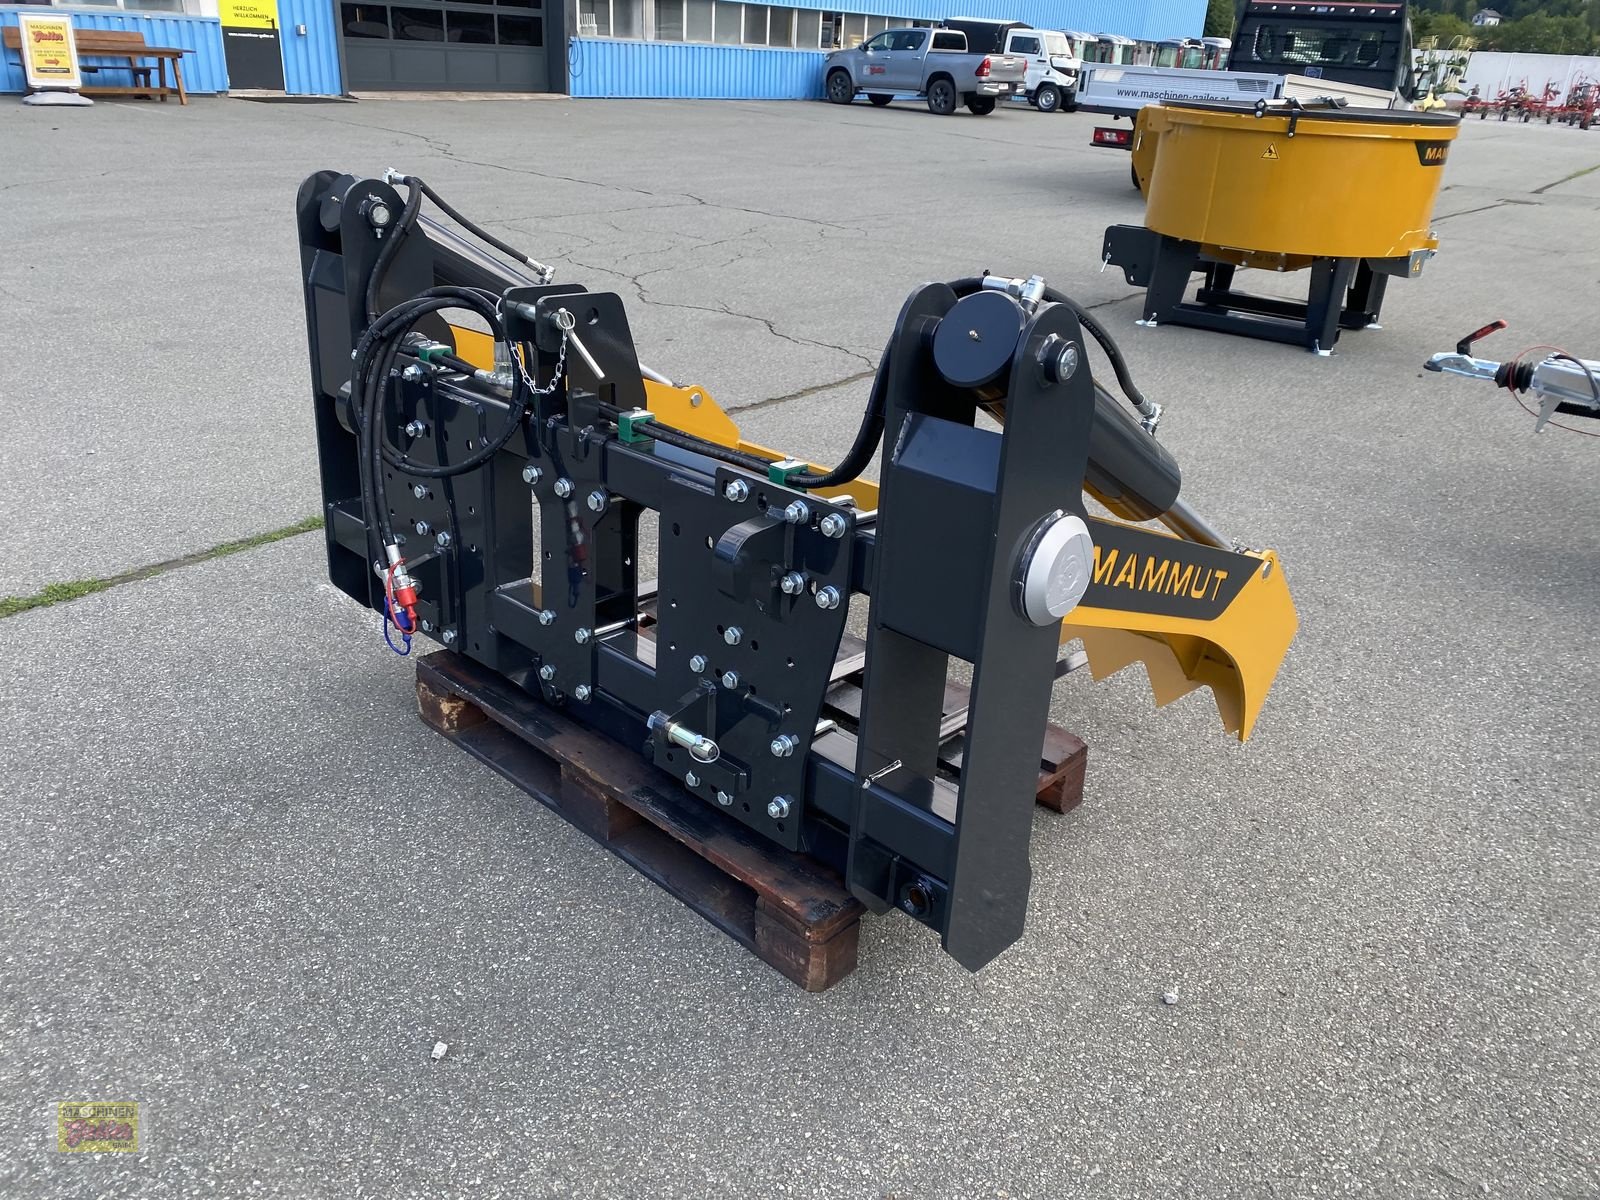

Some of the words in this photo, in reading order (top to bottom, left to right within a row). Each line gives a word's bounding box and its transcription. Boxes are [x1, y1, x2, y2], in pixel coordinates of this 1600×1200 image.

[233, 12, 269, 20] WILLKOMMEN
[1117, 88, 1230, 101] www.maschinen-gailerat
[1093, 545, 1230, 601] MAMMUT
